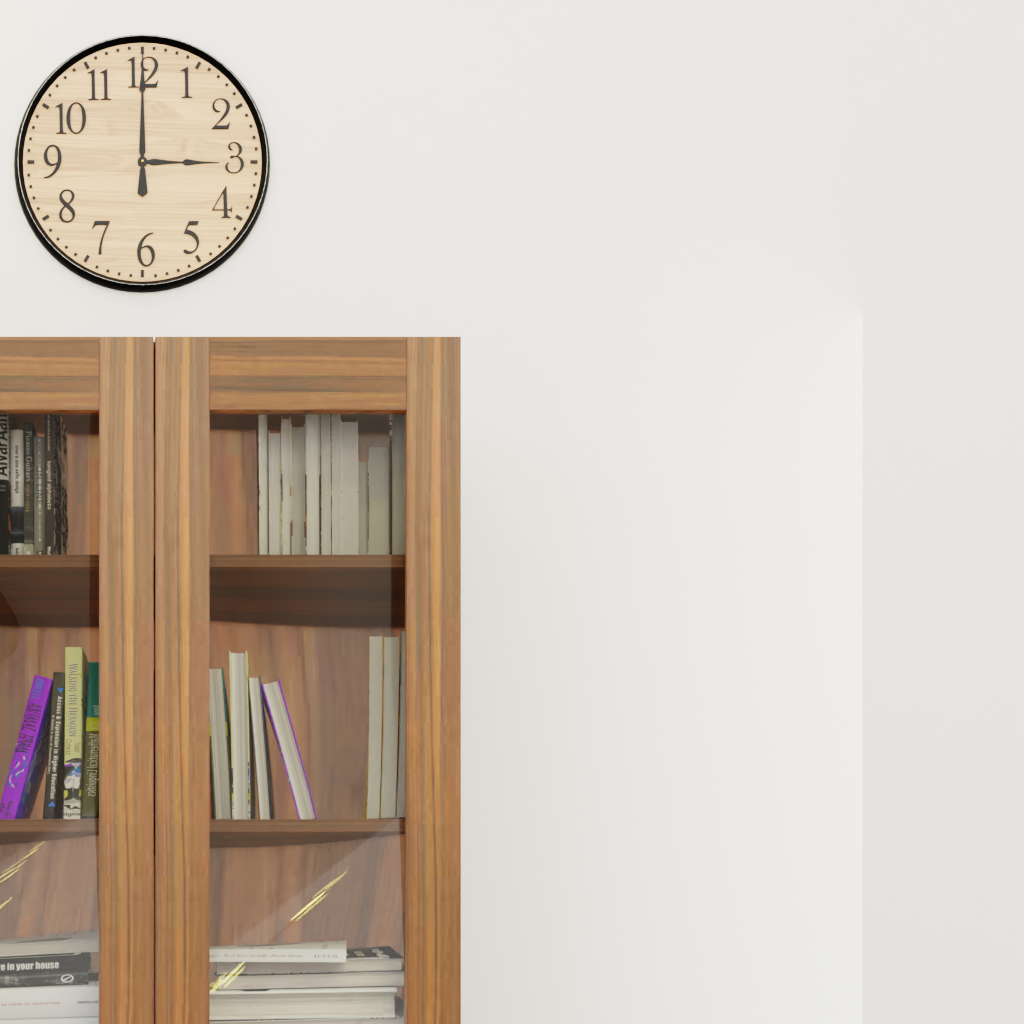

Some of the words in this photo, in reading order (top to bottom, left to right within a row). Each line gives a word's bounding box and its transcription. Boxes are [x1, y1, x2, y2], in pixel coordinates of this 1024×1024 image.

[87, 69, 112, 100] 11
[127, 56, 159, 88] 12
[181, 67, 192, 99] 1
[55, 102, 87, 134] 10
[211, 98, 230, 130] 2
[43, 144, 62, 179] 9
[224, 142, 244, 174] 3
[59, 189, 76, 223] 8
[212, 186, 233, 219] 4
[92, 220, 110, 255] 7
[137, 232, 155, 267] 6
[183, 220, 199, 254] 5
[30, 678, 44, 699] ORWELL
[21, 701, 43, 732] ANIMAL
[53, 721, 61, 747] Expansion
[7, 963, 15, 971] in
[16, 963, 33, 972] your
[35, 961, 60, 970] house
